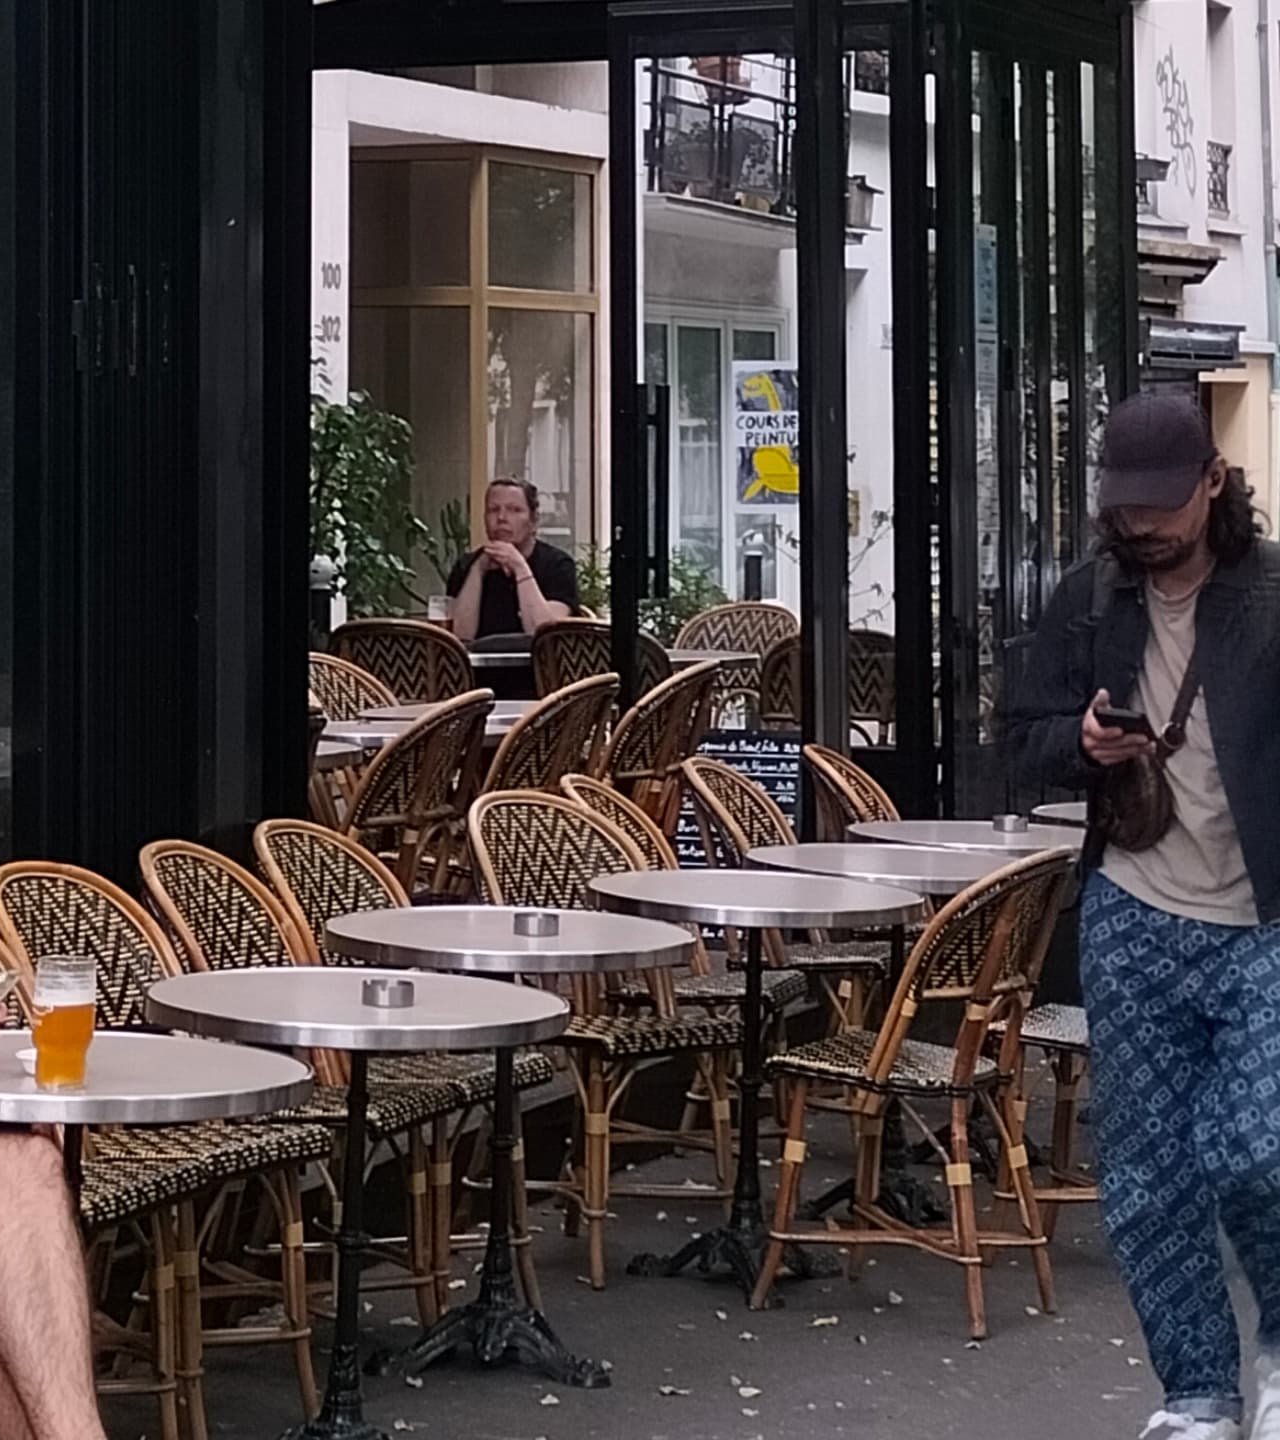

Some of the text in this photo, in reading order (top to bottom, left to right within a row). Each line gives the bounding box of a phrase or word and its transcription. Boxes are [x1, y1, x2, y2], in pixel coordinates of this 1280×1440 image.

[321, 262, 341, 290] 100
[321, 315, 341, 343] 102
[736, 415, 780, 430] COURS
[745, 431, 797, 447] PEINTU
